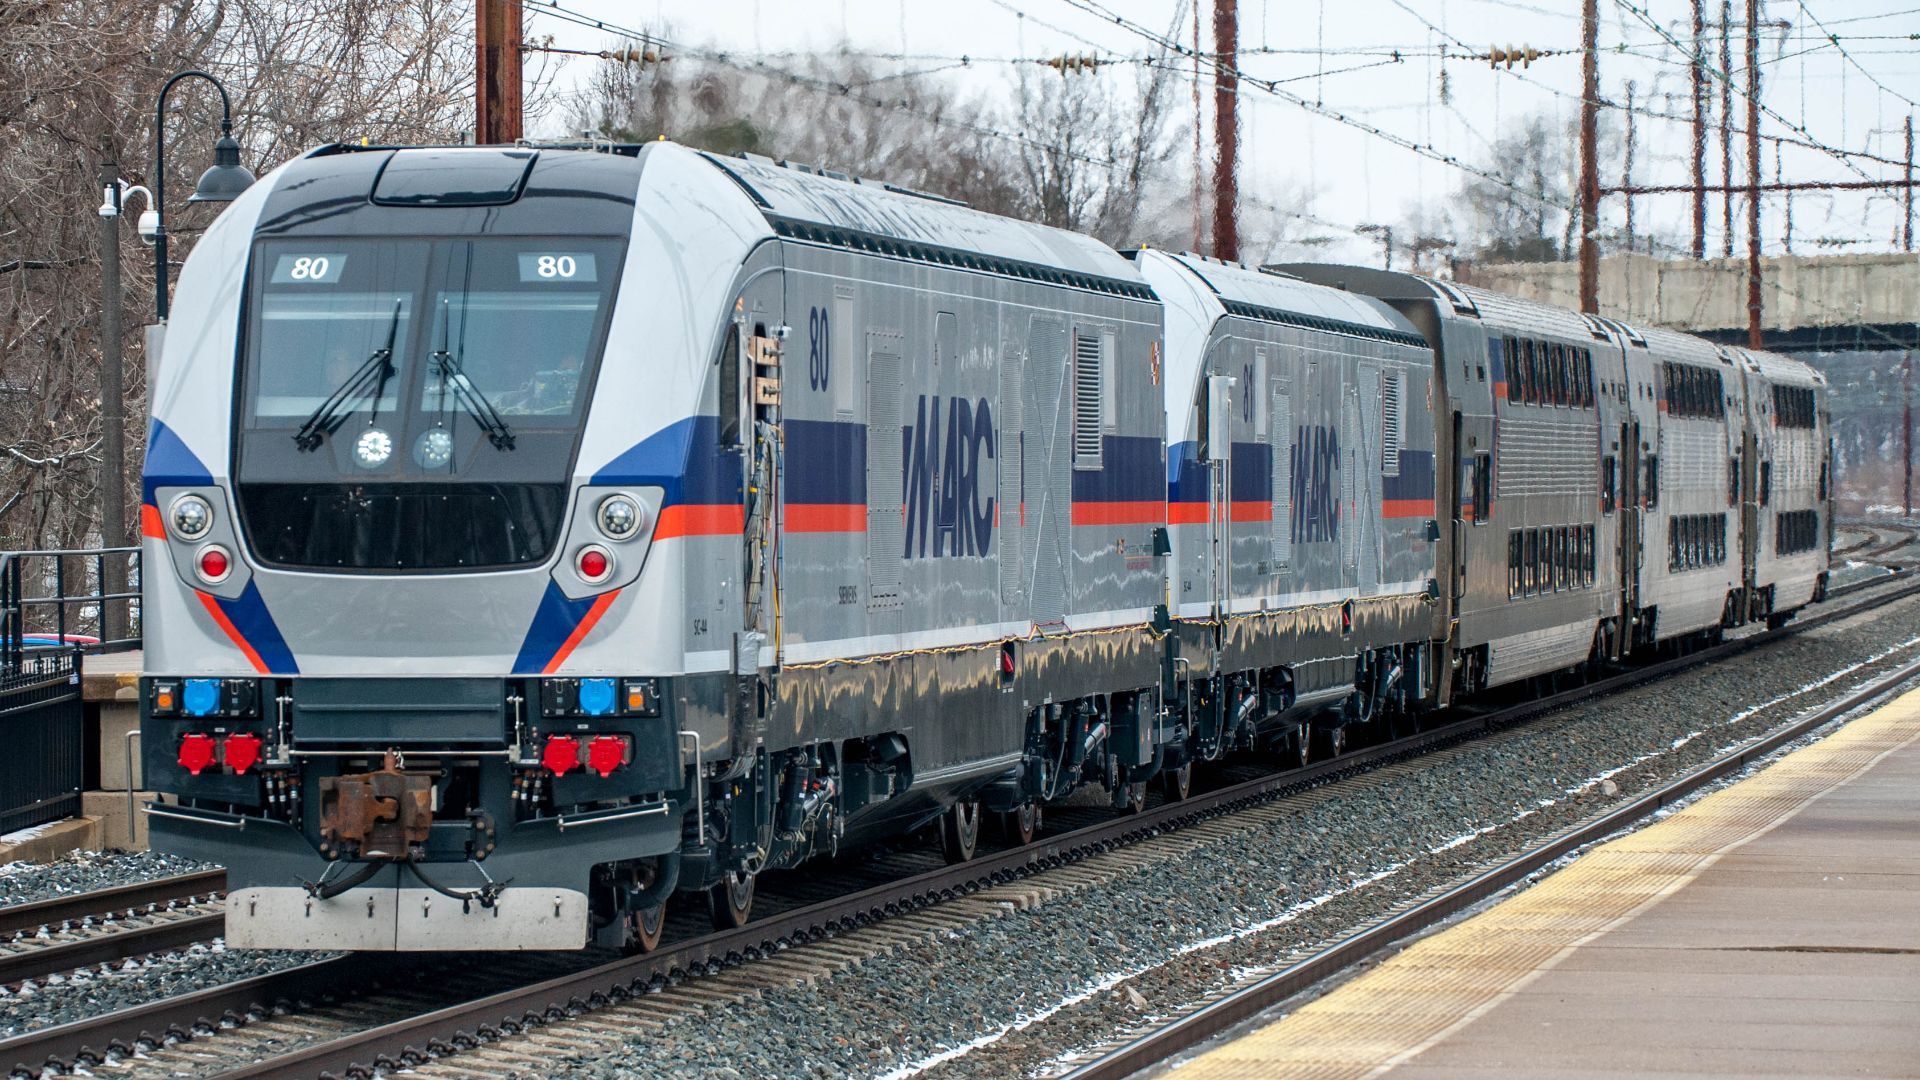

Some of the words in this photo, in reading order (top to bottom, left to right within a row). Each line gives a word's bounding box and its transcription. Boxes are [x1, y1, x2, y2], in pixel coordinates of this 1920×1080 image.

[291, 257, 328, 280] 80
[537, 255, 576, 278] 80
[809, 306, 829, 393] 80
[1243, 363, 1253, 423] 81
[904, 394, 994, 560] MARC
[1291, 425, 1338, 545] MARC
